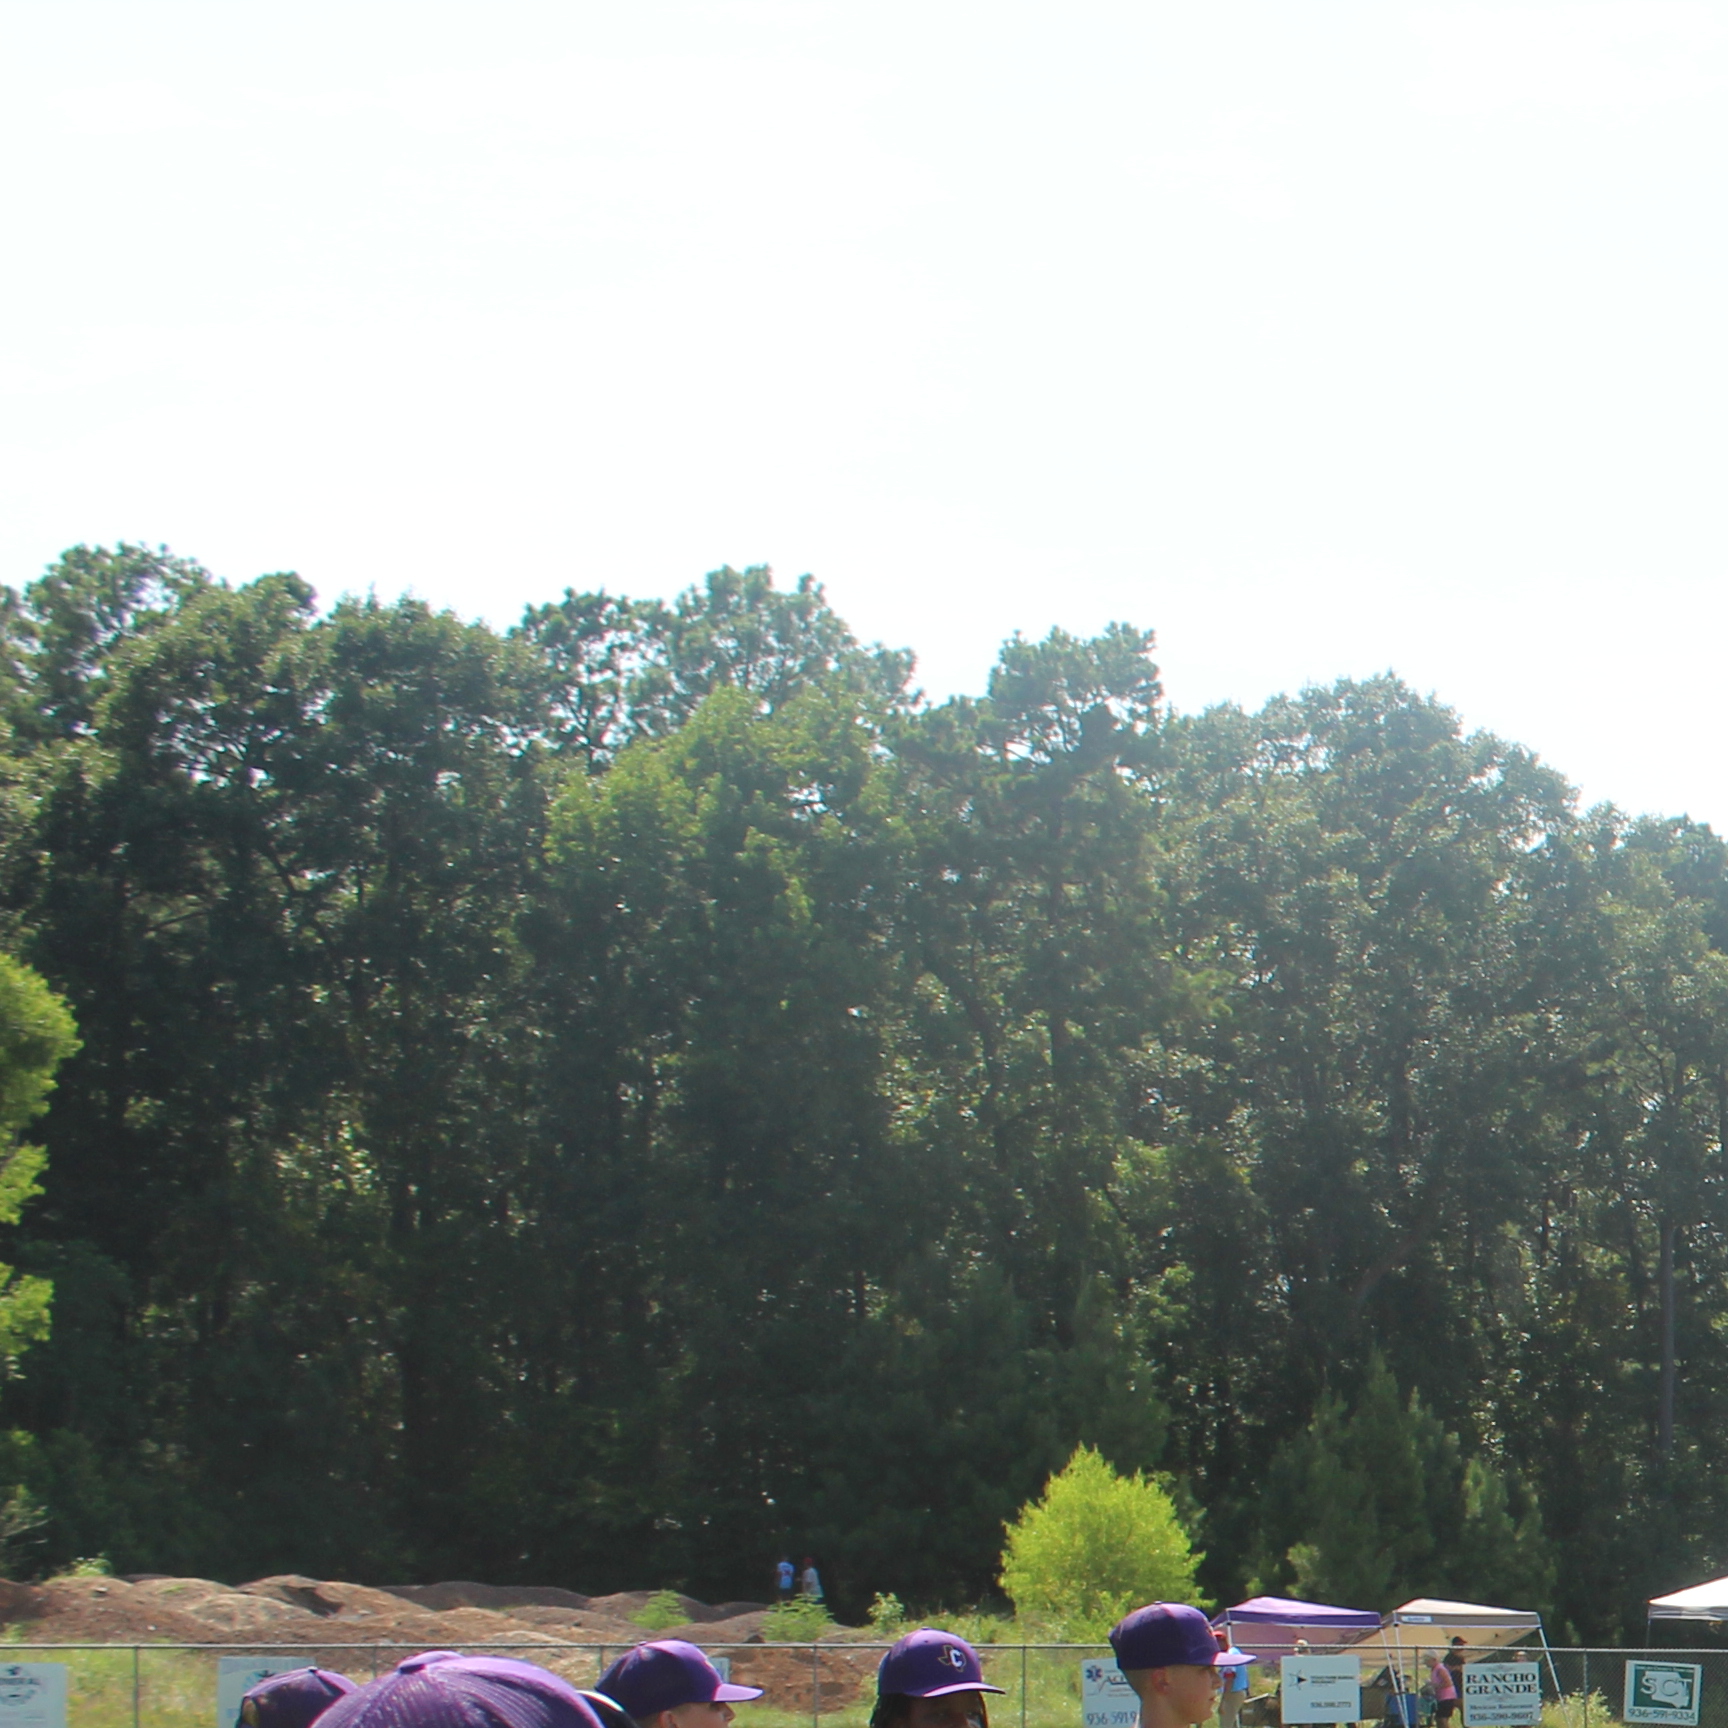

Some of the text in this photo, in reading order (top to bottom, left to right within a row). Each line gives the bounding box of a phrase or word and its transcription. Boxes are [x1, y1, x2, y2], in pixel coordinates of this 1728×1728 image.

[950, 1649, 962, 1667] C
[1466, 1673, 1536, 1683] RANCHO
[1466, 1684, 1537, 1695] GRANDE
[1640, 1675, 1693, 1696] SCT
